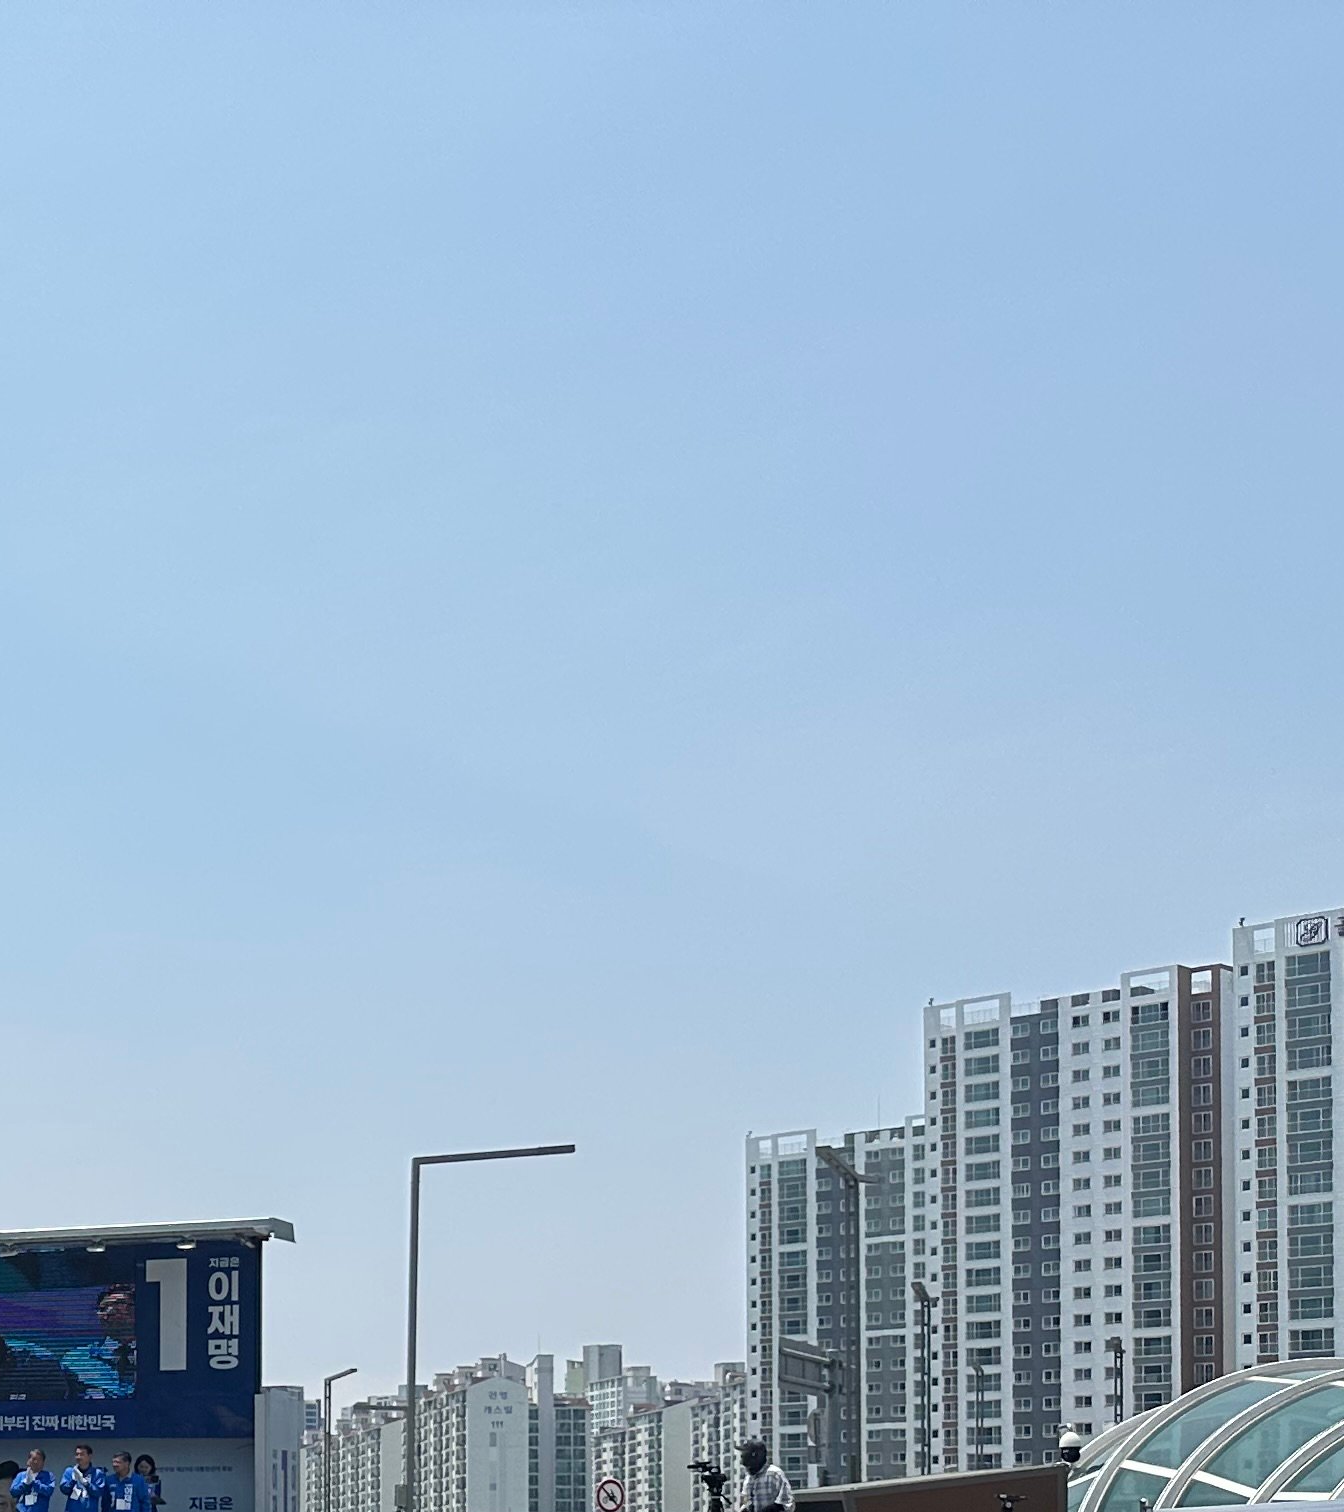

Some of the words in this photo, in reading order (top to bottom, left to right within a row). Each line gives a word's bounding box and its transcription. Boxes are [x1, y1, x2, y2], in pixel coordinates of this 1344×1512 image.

[208, 1257, 240, 1268] 지금은
[145, 1258, 187, 1371] 1
[207, 1270, 240, 1370] 이재명
[32, 1415, 59, 1431] 진짜
[61, 1414, 116, 1431] 대한민국
[189, 1496, 233, 1511] 지금은
